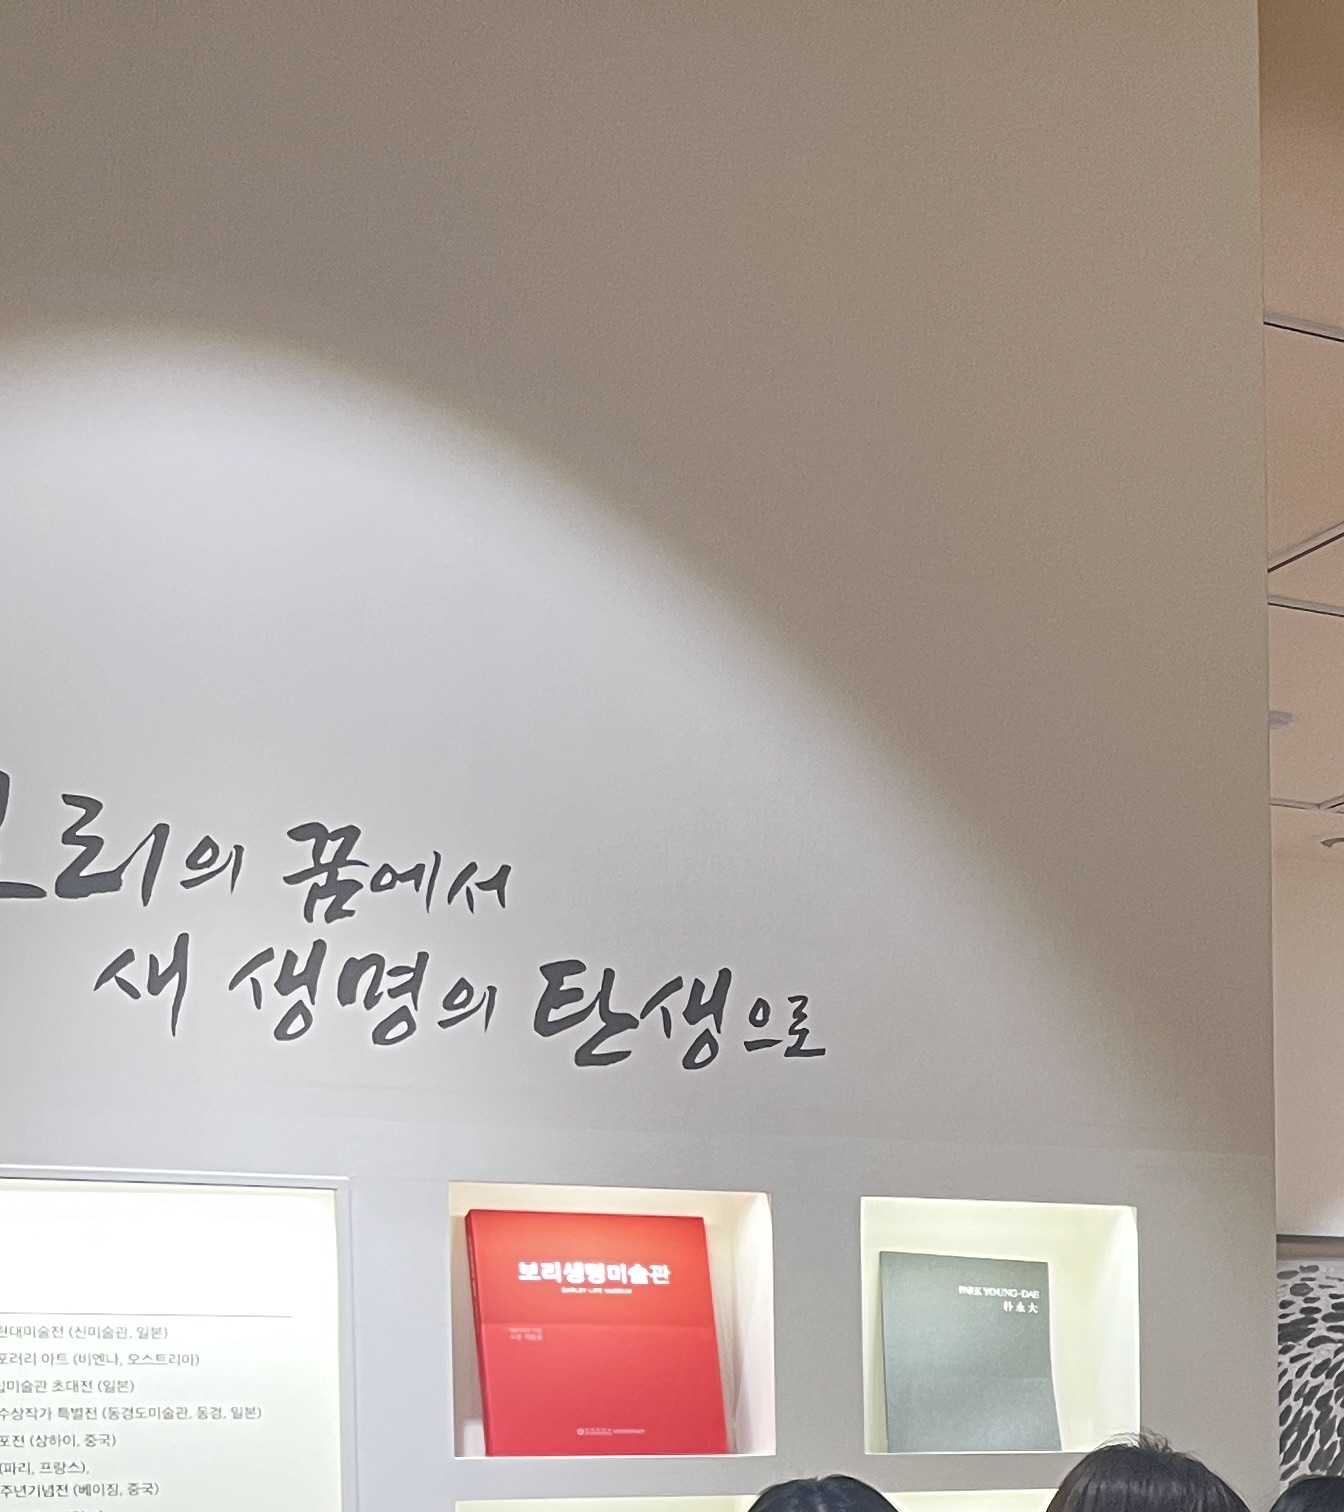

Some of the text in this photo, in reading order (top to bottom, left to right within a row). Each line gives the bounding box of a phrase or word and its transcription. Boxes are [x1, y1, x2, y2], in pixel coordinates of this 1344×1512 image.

[283, 822, 511, 924] 꿈에서
[94, 933, 826, 1069] 새 생명의 탄생으로
[518, 1261, 671, 1285] 보리생명미술관
[958, 1285, 1040, 1299] PARK YOUNG-DAE
[136, 1326, 169, 1340] 일본)
[41, 1352, 70, 1367] 아트
[127, 1353, 200, 1367] 오스트리아)
[51, 1379, 94, 1394] 초대전
[97, 1379, 135, 1394] (일본)
[57, 1406, 98, 1421] 특별전
[230, 1406, 262, 1420] 일본)
[29, 1434, 80, 1448] (상하이,
[84, 1433, 117, 1447] 중국)
[73, 1482, 123, 1498] (베이징,
[127, 1482, 160, 1496] 중국)
